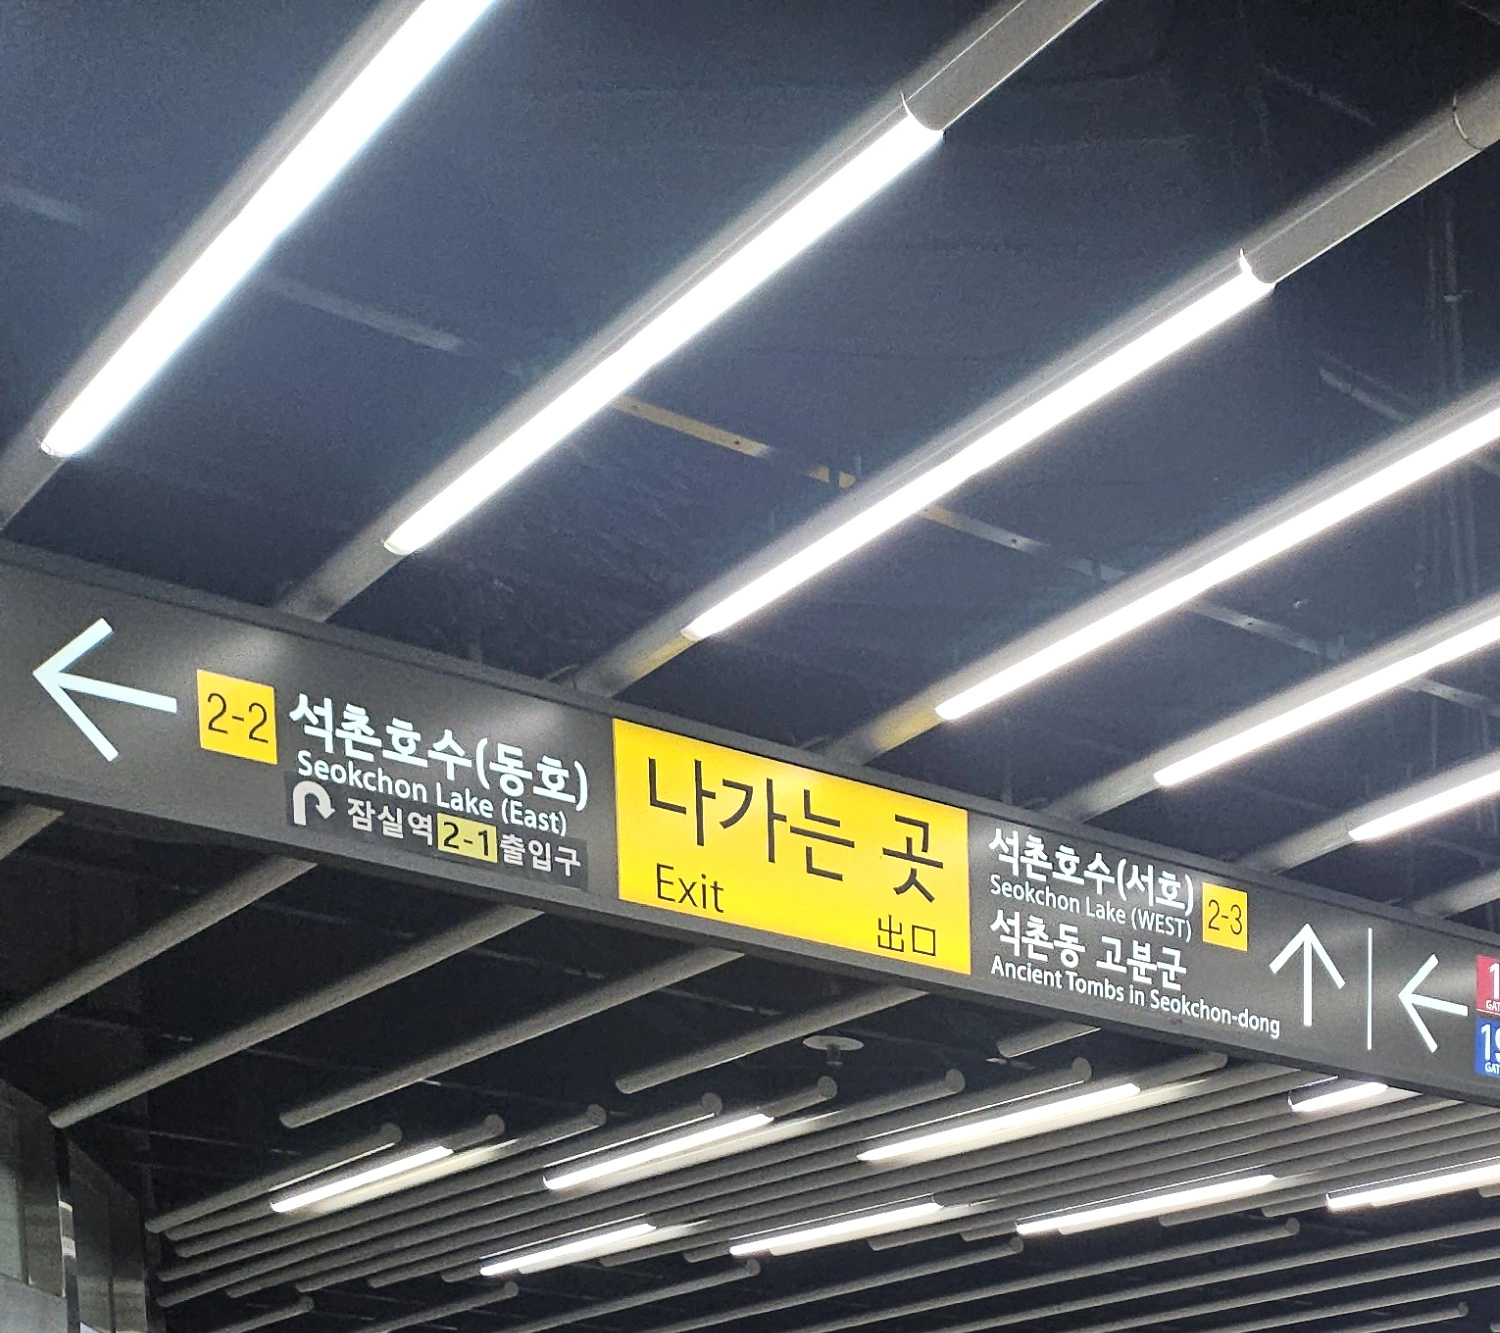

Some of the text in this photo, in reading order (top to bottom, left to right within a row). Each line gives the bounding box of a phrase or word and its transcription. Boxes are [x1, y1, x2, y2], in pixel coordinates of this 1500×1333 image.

[207, 692, 270, 743] 2-2
[290, 693, 588, 812] 석촌호수(동호)
[297, 750, 567, 836] Seokchon Lake (East)
[648, 756, 943, 903] 나가는 곳
[347, 798, 581, 877] 잠실역 2-1 출입구
[988, 828, 1194, 916] 석촌호수(서호)
[655, 864, 724, 913] Exit
[990, 874, 1192, 942] Seokchon Lake (WEST)
[1208, 899, 1243, 935] 2-3
[878, 914, 937, 957] 出口
[990, 909, 1187, 991] 석촌동 고분군
[991, 955, 1280, 1039] Ancient Tombs in Seokchon-dong
[1489, 963, 1500, 1000] 1
